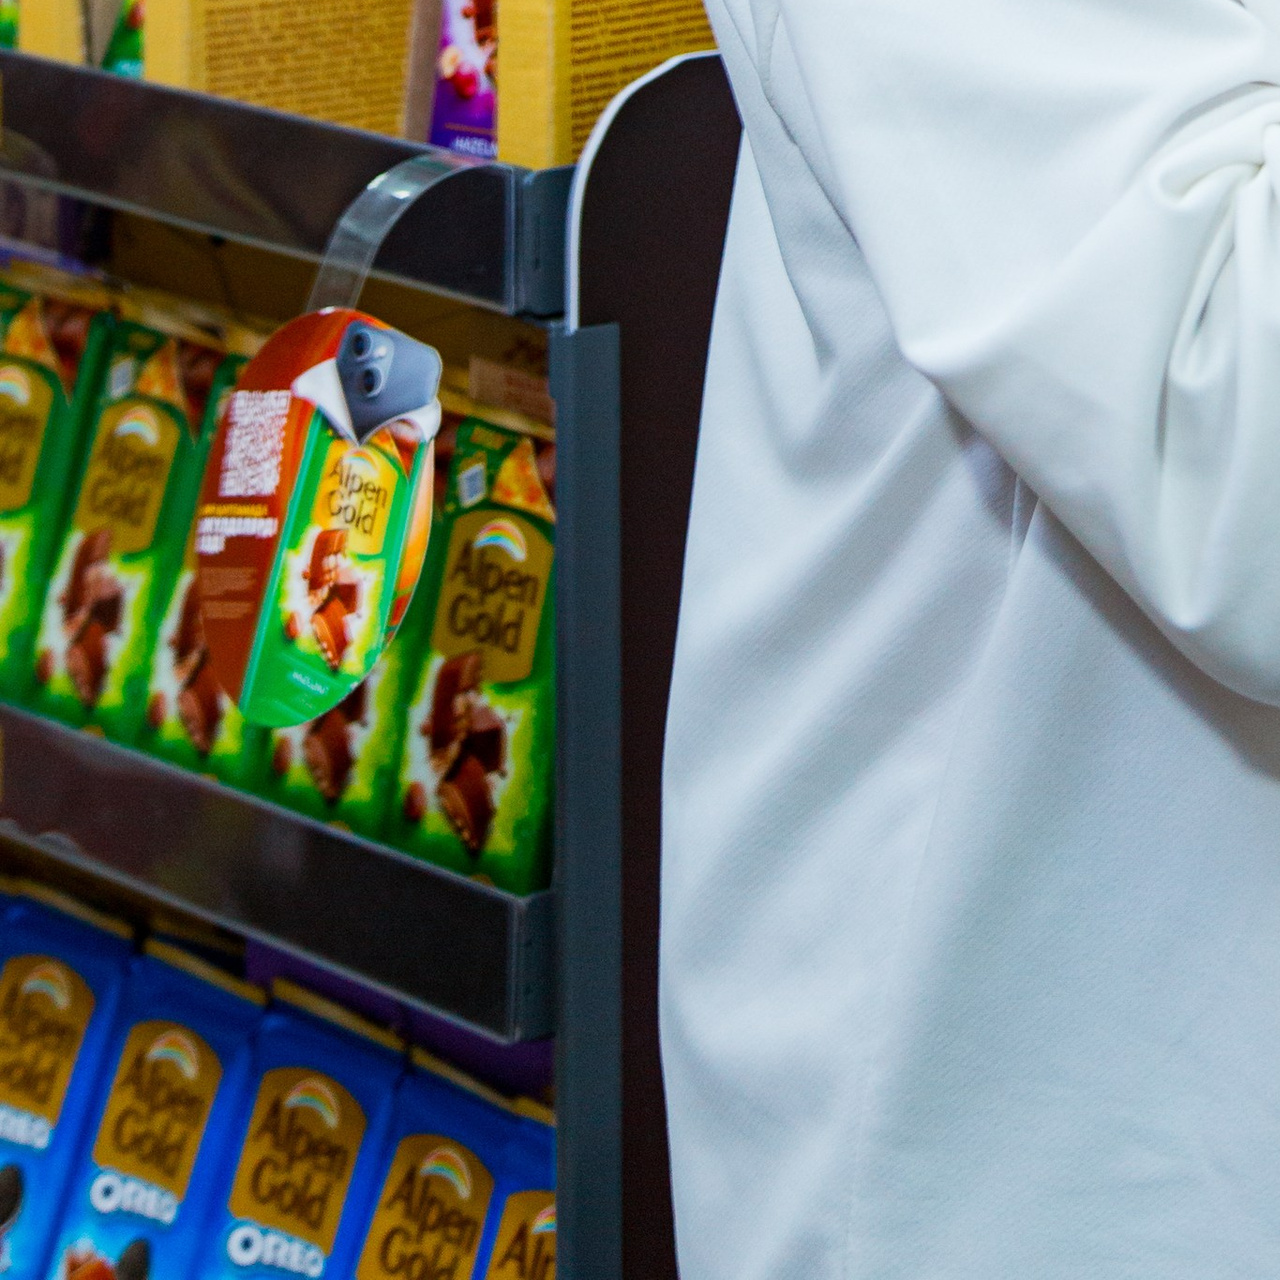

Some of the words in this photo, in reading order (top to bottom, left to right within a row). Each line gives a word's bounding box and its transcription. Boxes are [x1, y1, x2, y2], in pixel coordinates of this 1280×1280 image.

[327, 489, 378, 536] Gold
[329, 458, 388, 508] Alpen
[452, 540, 539, 607] Alpen
[449, 592, 525, 654] Gold
[253, 1095, 350, 1179] Alpen
[251, 1156, 332, 1231] Gold
[386, 1163, 479, 1253] Alpen
